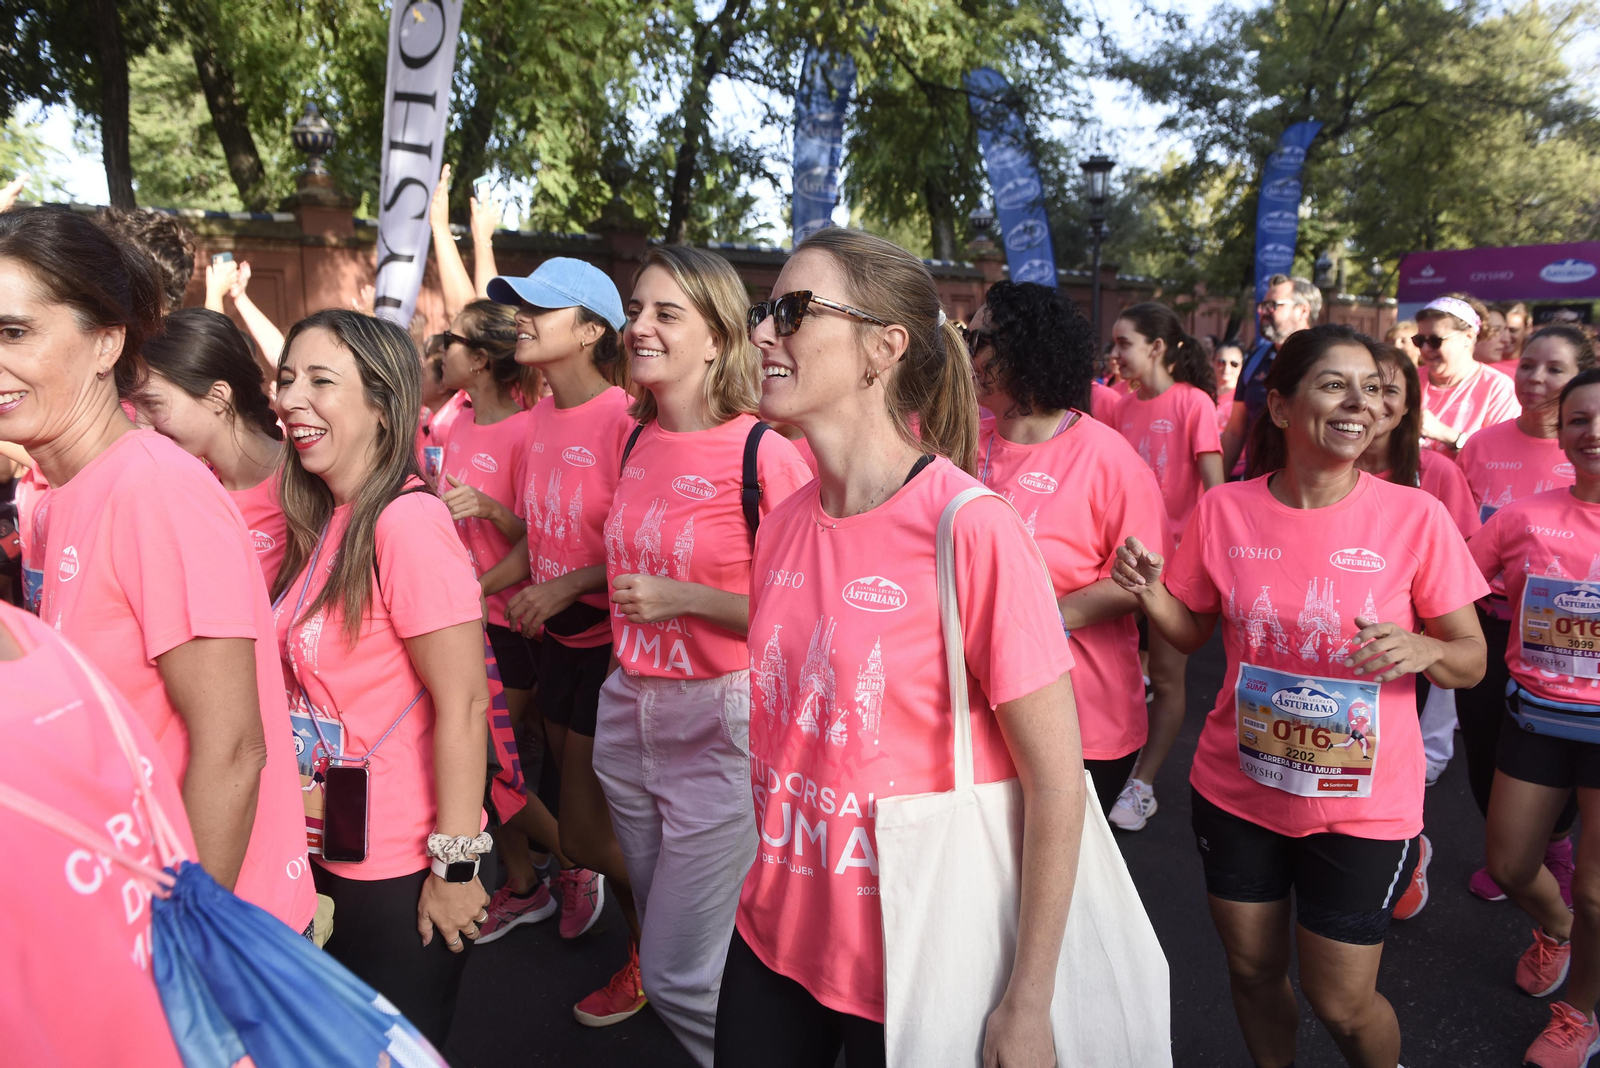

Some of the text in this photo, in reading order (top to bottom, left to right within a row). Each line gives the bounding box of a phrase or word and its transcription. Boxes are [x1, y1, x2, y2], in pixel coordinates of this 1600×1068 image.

[1470, 270, 1514, 282] OYSHO
[1486, 461, 1522, 470] OYSHO
[675, 480, 712, 497] ASTURIANA
[1525, 525, 1574, 539] OYSHO
[1228, 546, 1282, 560] OYSHO
[1334, 555, 1381, 569] ASTURIANA
[846, 586, 901, 606] ASTURIANA
[1568, 639, 1594, 649] 3099
[1531, 655, 1566, 668] OYSHO
[1245, 682, 1267, 693] SUMA
[1275, 694, 1333, 713] ASTURIANA
[1273, 719, 1331, 749] 016
[1286, 747, 1315, 762] 2202
[1258, 752, 1342, 774] CARRERA DE LA MUJER
[1245, 762, 1283, 781] OYSHO
[762, 852, 814, 877] DE LA UJER
